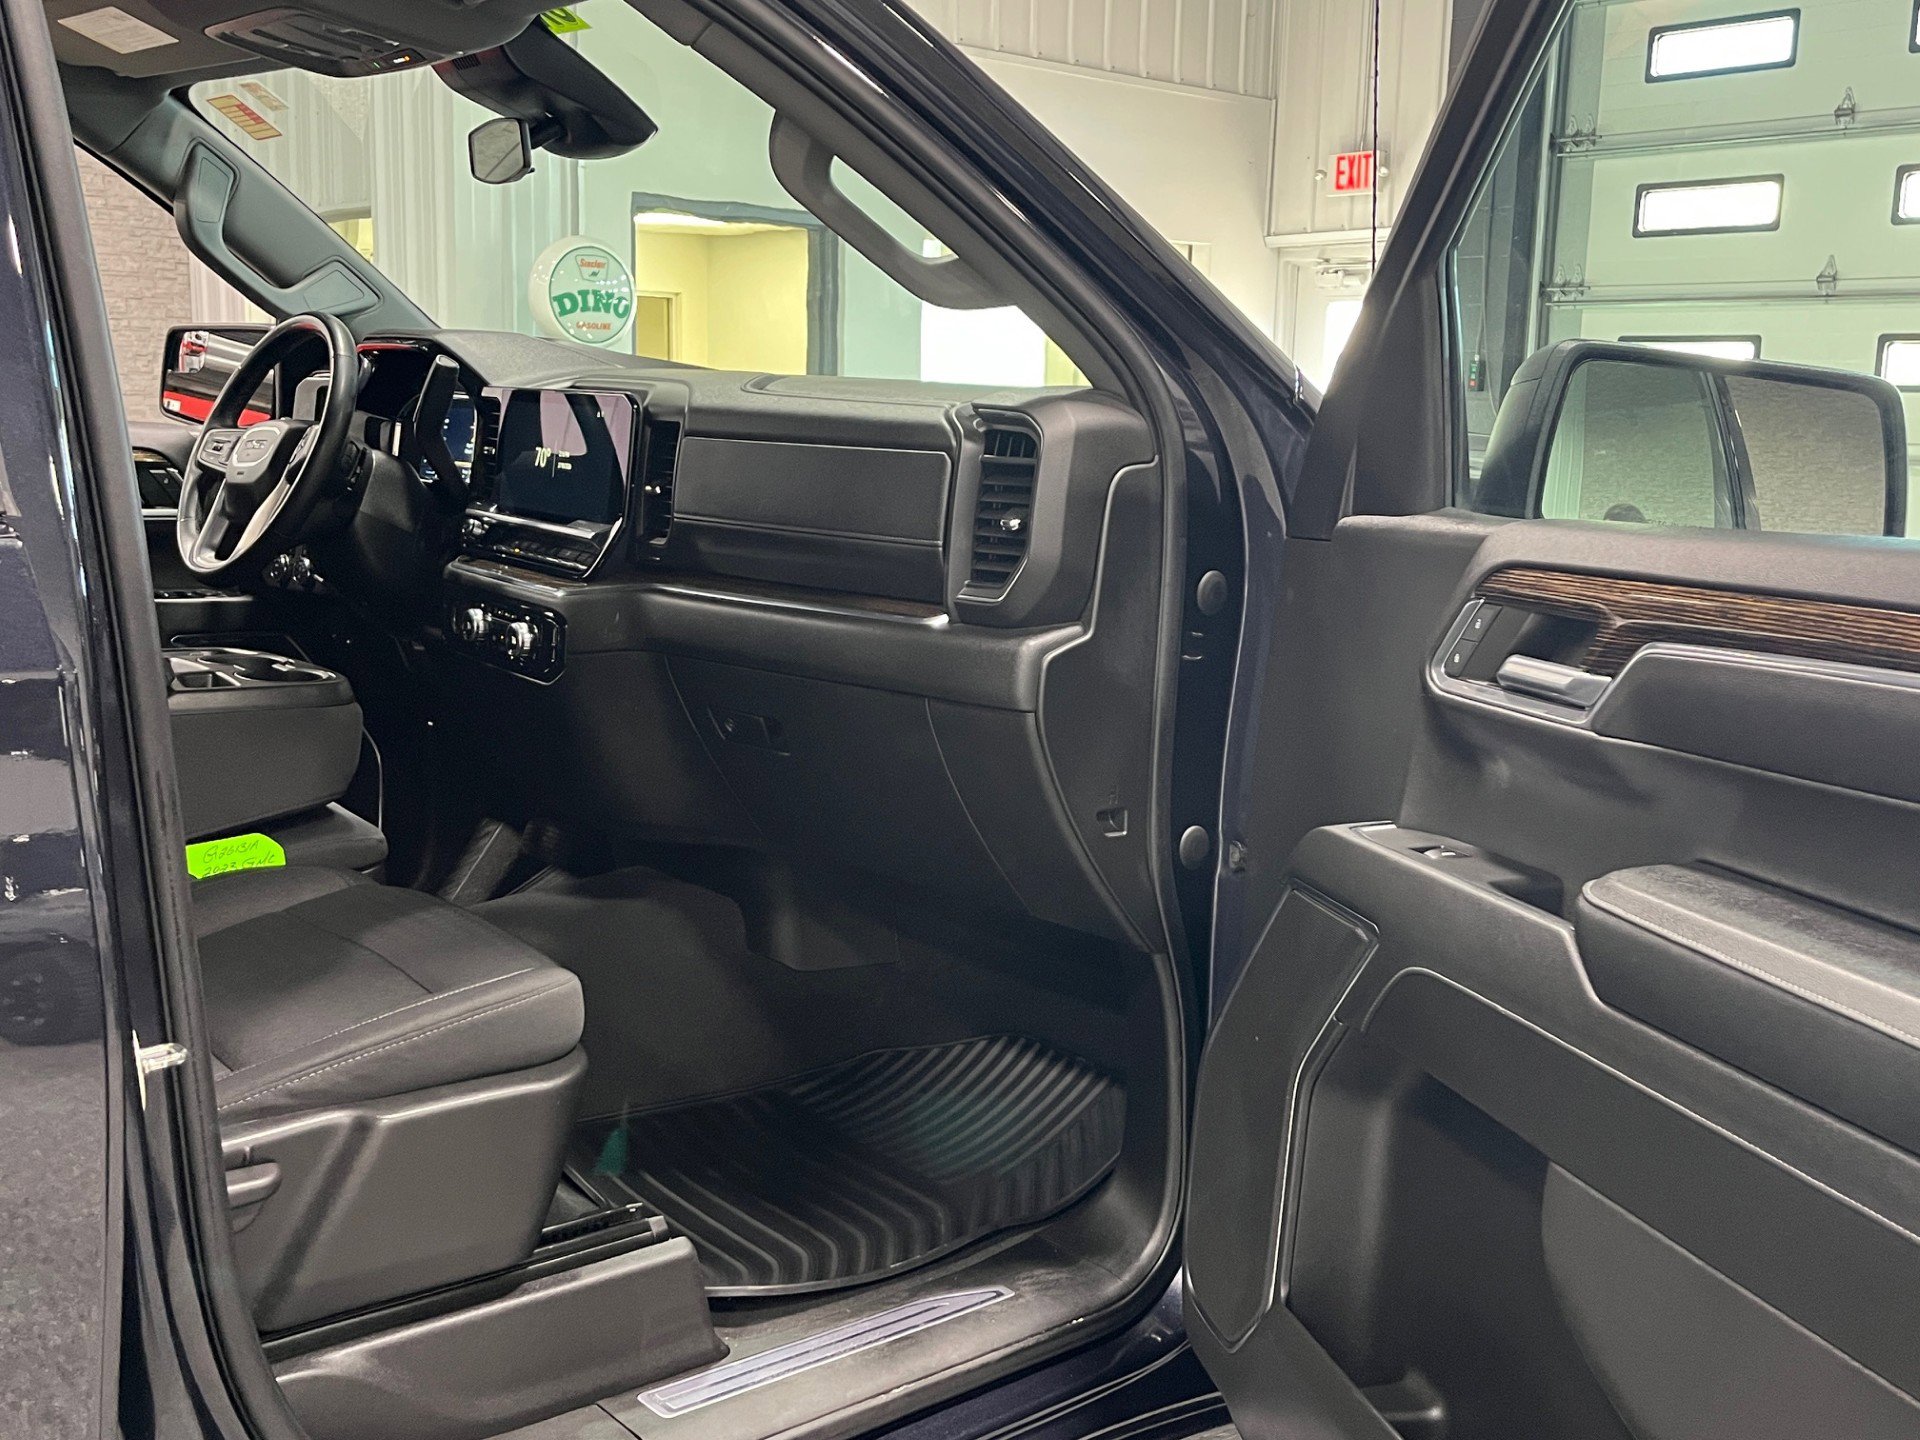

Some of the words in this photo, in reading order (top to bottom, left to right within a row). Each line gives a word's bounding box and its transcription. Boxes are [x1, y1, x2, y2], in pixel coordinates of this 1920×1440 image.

[1336, 153, 1372, 190] EXIT
[552, 289, 629, 318] DINO
[576, 321, 611, 330] GASOLINE
